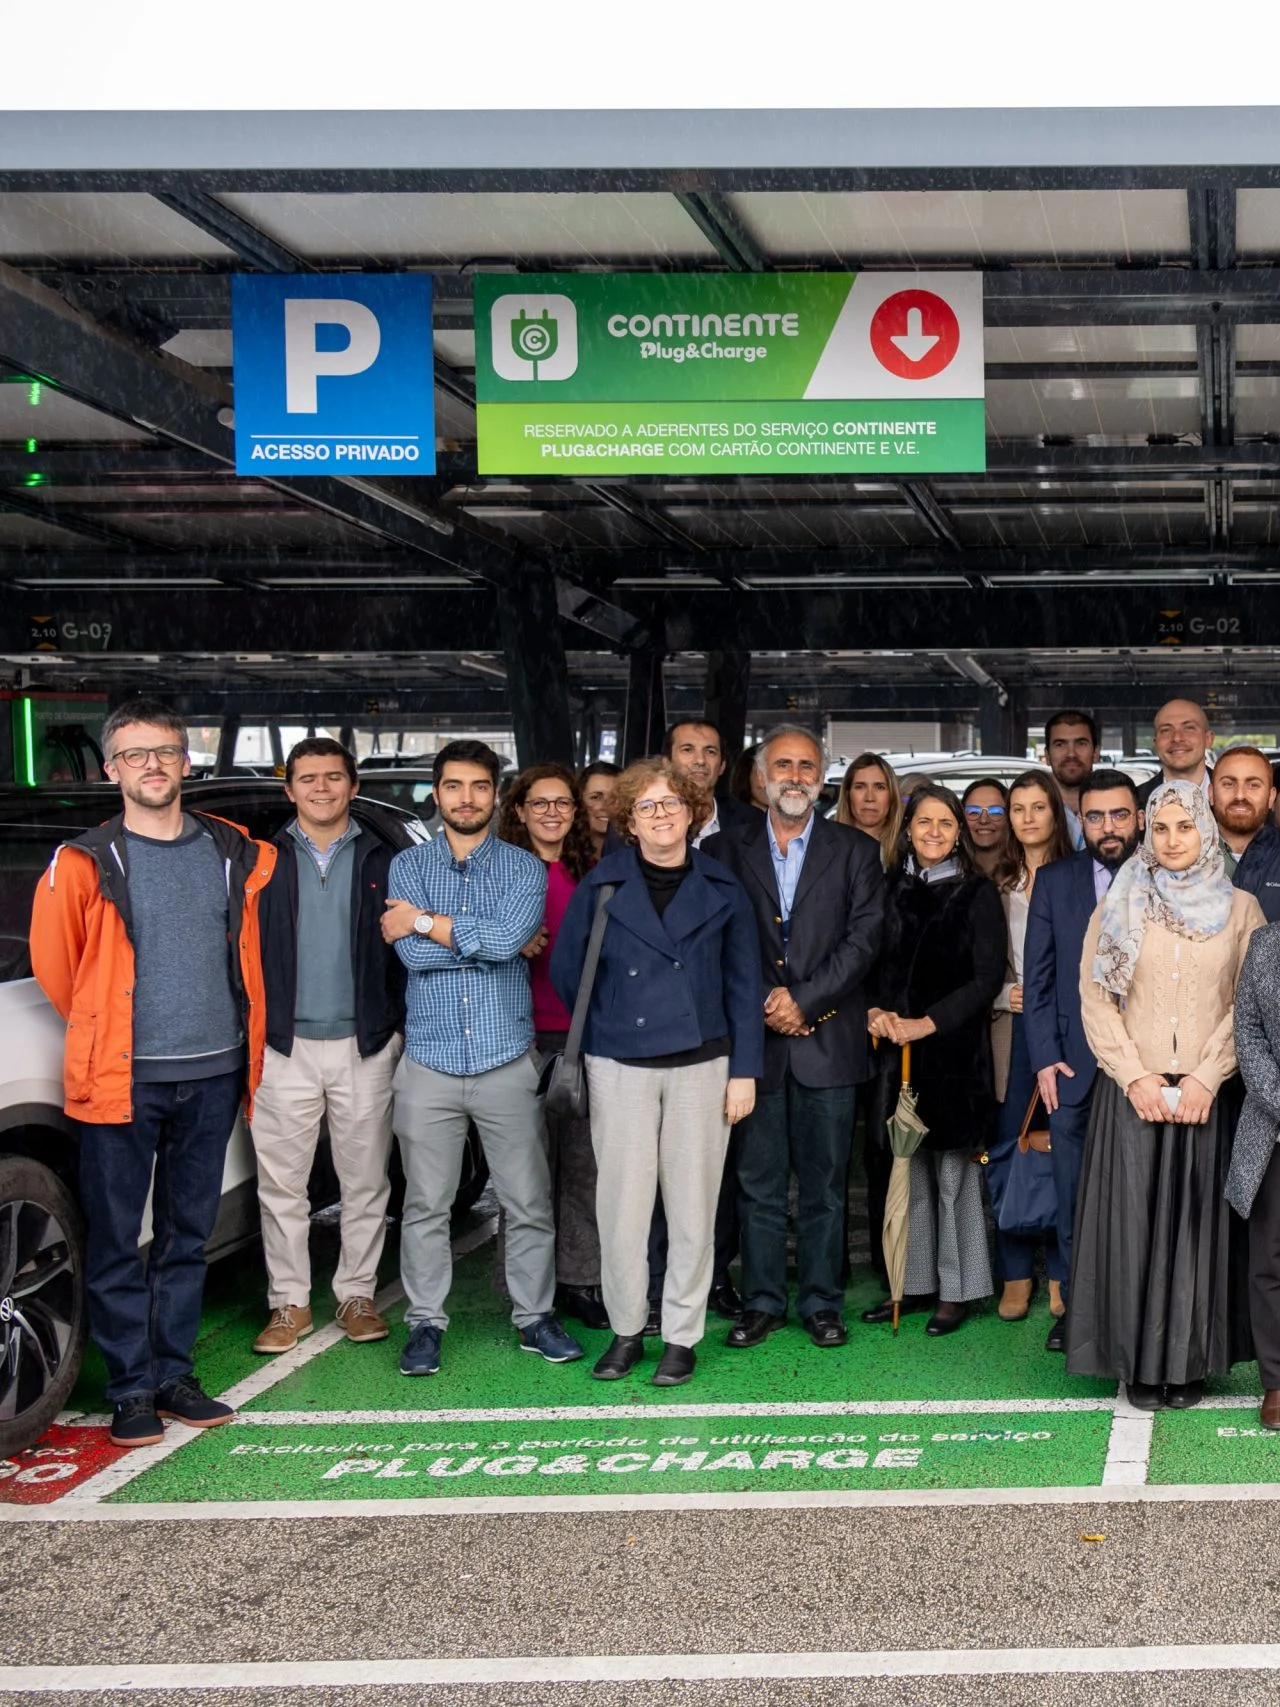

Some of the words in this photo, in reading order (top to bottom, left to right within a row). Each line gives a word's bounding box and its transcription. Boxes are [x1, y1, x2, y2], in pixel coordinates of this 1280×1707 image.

[608, 313, 798, 337] CONTINENTE
[285, 298, 381, 413] P
[640, 342, 767, 363] Plug&Charge
[524, 424, 618, 438] RESERVADO
[622, 424, 633, 437] A
[637, 423, 729, 437] ADERENTES
[734, 422, 756, 437] DO
[761, 422, 828, 439] SERVIÇO
[833, 421, 936, 436] CONTINENTE
[251, 444, 330, 460] ACESSO
[335, 444, 419, 461] PRIVADO
[541, 443, 663, 457] PLUG&CHARGE
[668, 443, 705, 457] COM
[710, 440, 772, 457] CARTÃO
[777, 441, 875, 456] CONTINENTE
[880, 441, 889, 455] E
[893, 441, 920, 455] V.E.
[31, 628, 57, 638] 2.10
[1158, 623, 1184, 632] 2.10
[1189, 617, 1240, 634] G-02
[230, 1443, 395, 1455] Exclusivo
[400, 1441, 479, 1453] para
[488, 1441, 510, 1449] o
[658, 1436, 699, 1445] de
[879, 1432, 920, 1442] do
[931, 1430, 1051, 1442] serviço
[320, 1448, 923, 1479] PLUG&CHARGE
